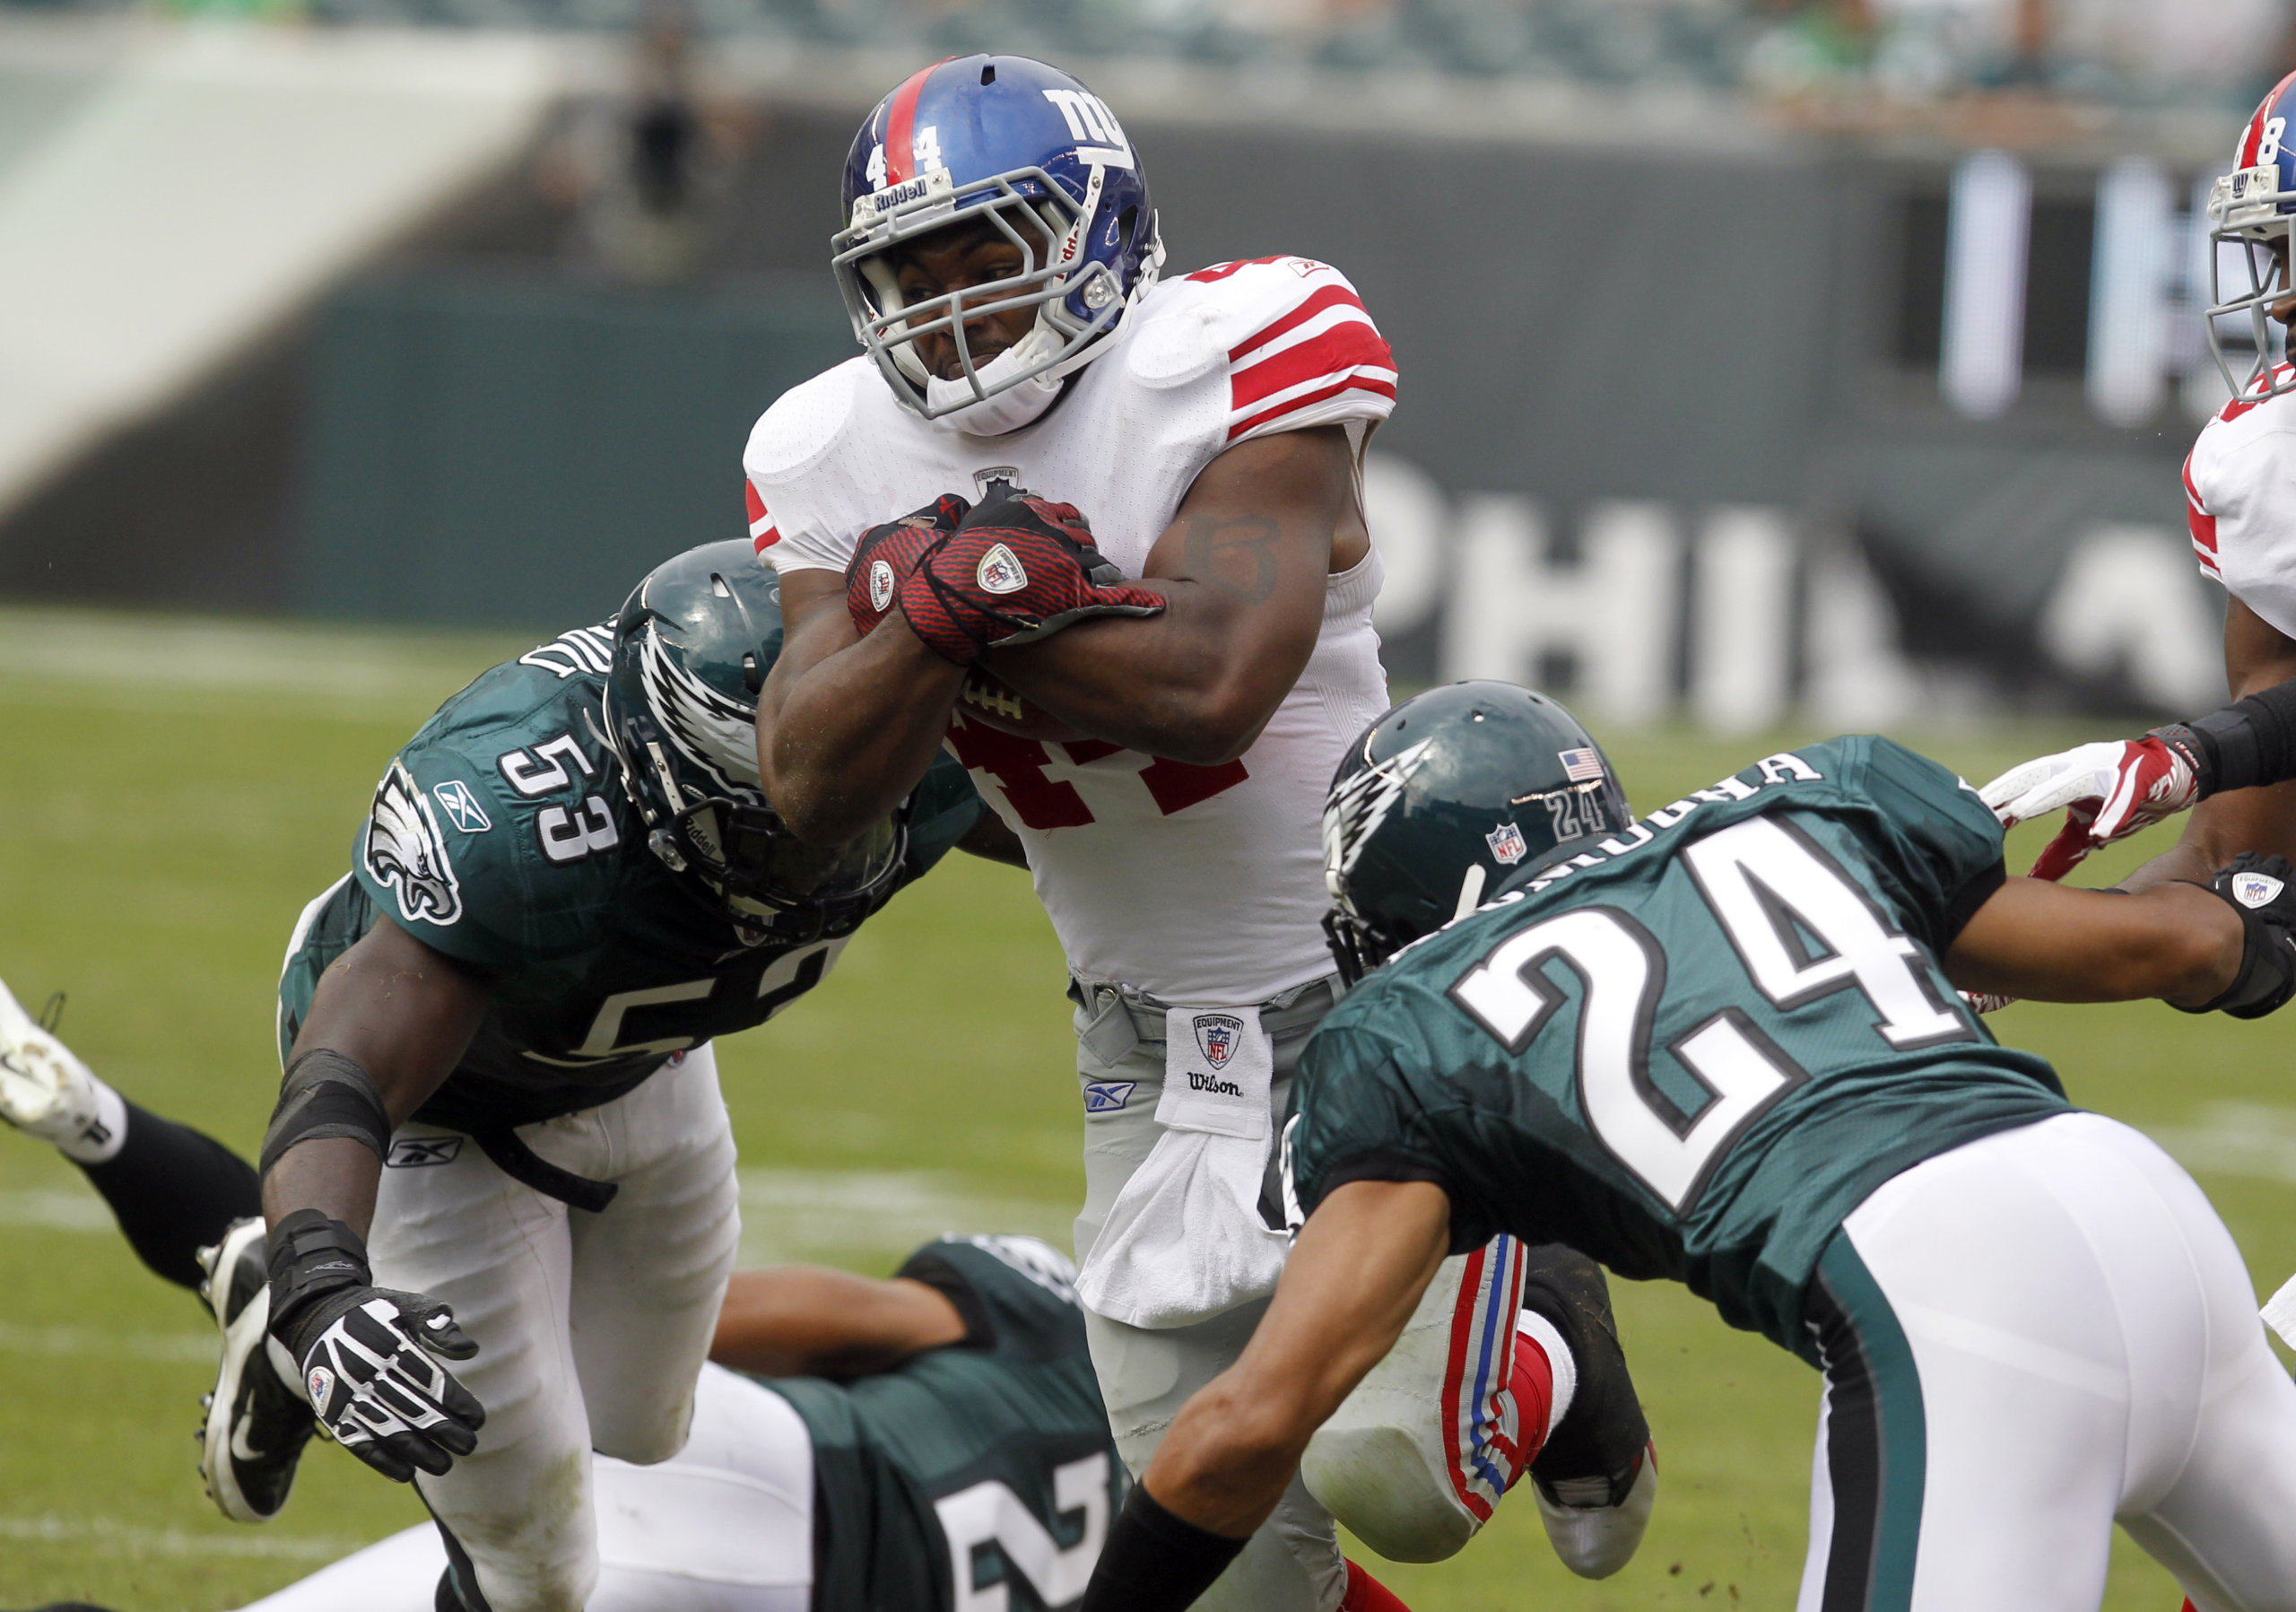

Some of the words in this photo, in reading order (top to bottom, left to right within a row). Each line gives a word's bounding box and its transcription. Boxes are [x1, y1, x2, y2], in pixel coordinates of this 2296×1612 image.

[874, 179, 927, 212] Riddell
[497, 729, 622, 867] 53
[1544, 788, 1606, 843] 24
[1496, 840, 1522, 858] NFL
[2246, 889, 2265, 900] NFL
[1196, 1017, 1240, 1031] EQUIPMENT
[1448, 813, 1979, 1216] 24
[1208, 1041, 1228, 1061] NFL
[1187, 1072, 1241, 1096] Wilson
